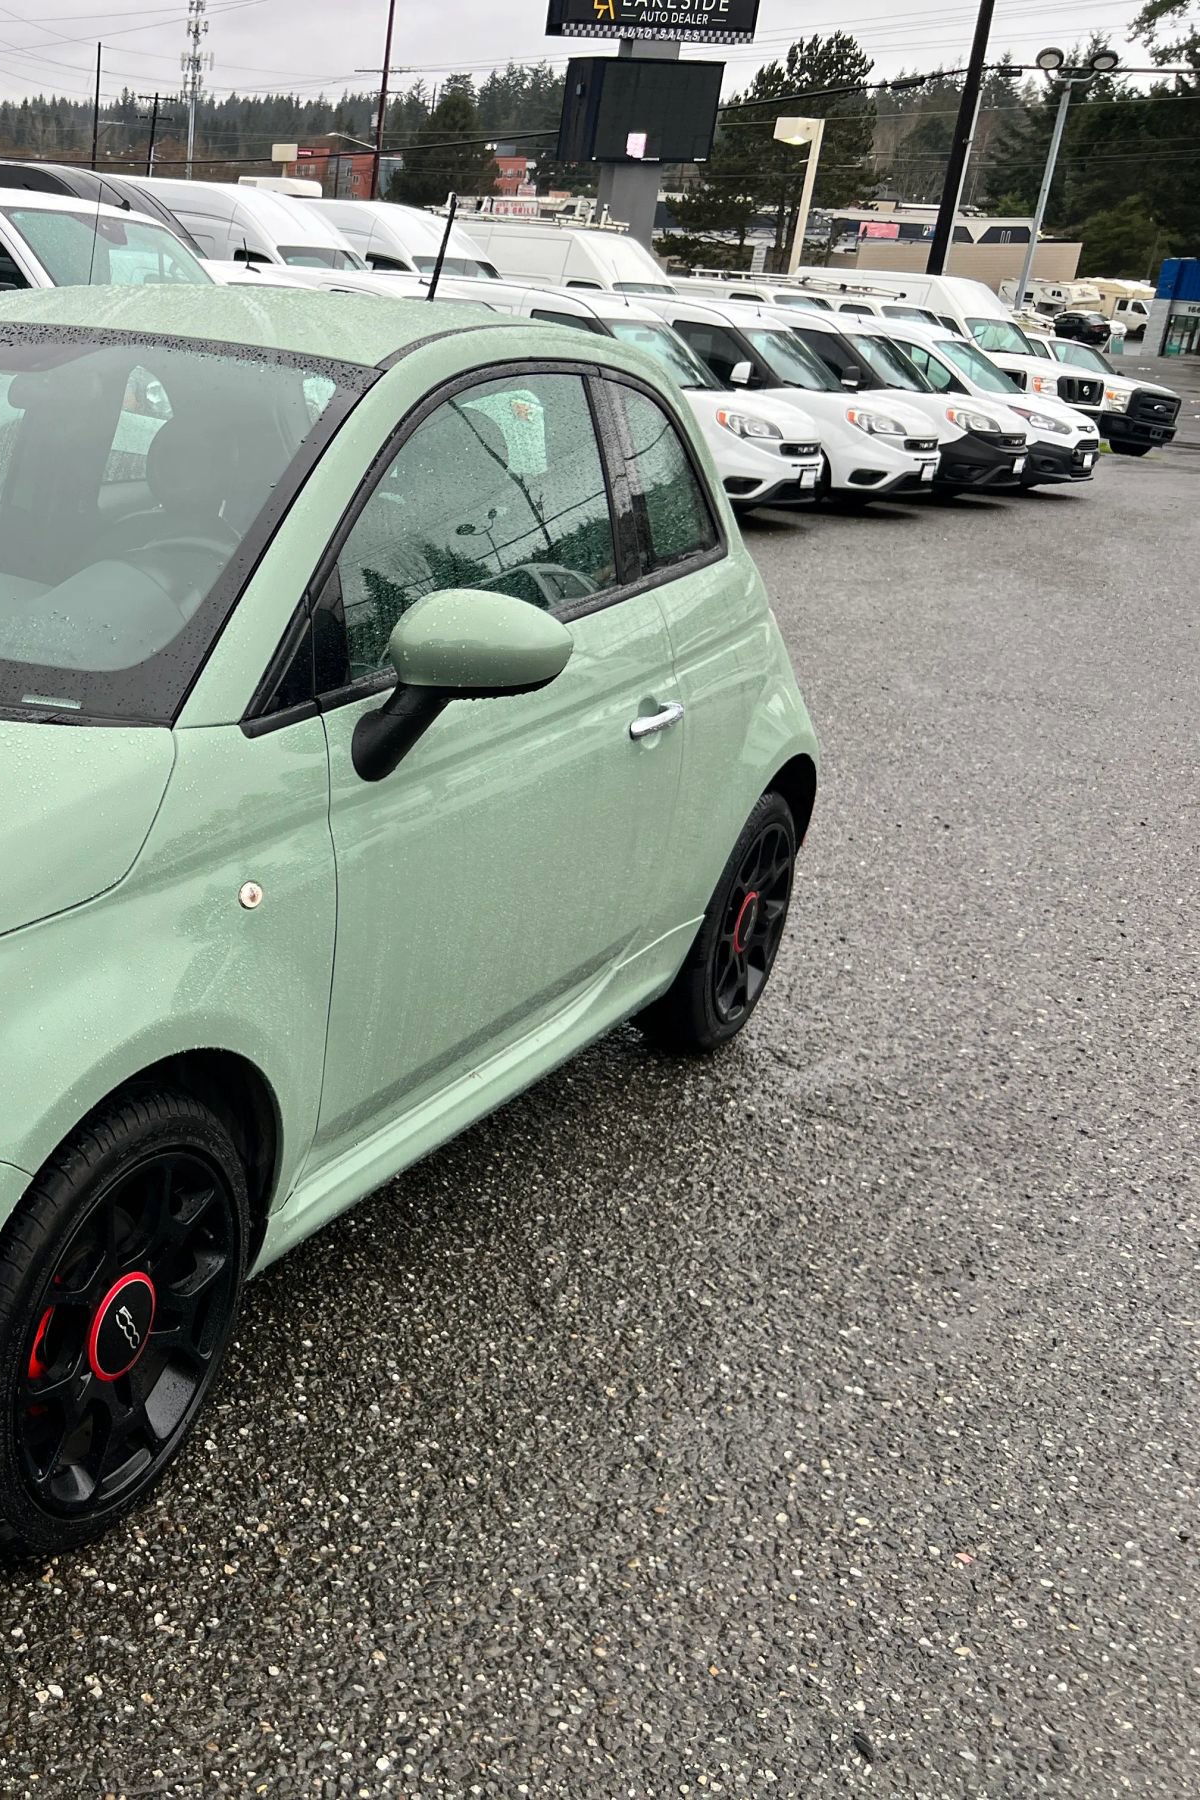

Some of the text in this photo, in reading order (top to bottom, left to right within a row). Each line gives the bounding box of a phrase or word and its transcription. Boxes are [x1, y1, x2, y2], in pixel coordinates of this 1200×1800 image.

[639, 11, 709, 25] AUTO DEALER
[618, 28, 701, 41] AUTO SALES
